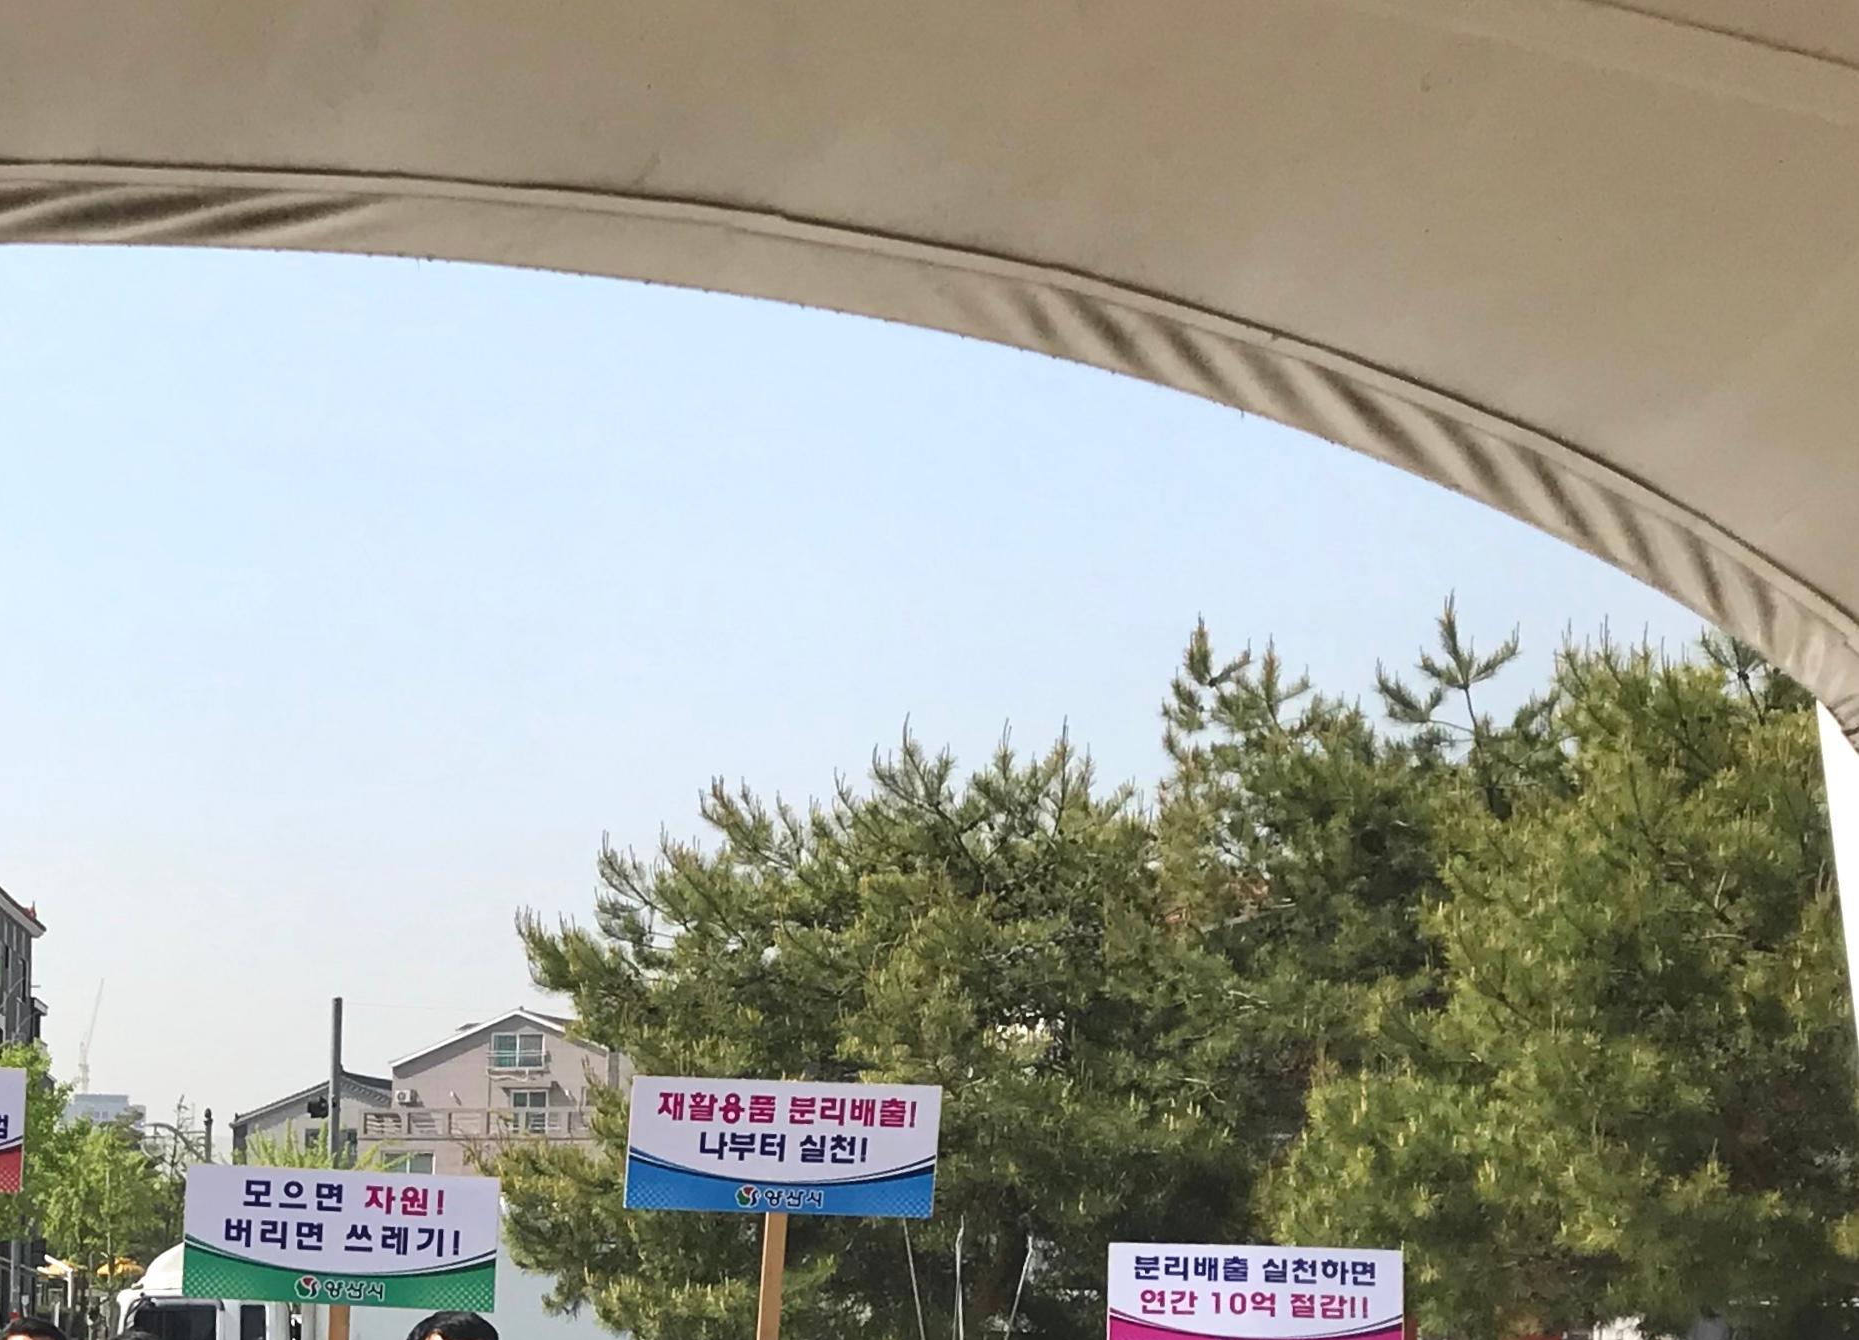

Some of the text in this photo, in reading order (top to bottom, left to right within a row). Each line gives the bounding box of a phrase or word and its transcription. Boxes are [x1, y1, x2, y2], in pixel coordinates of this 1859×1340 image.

[657, 1091, 917, 1128] 재활용품 분리배출!
[699, 1131, 868, 1164] 나부터 실천!
[243, 1179, 445, 1216] 모으면 자원!
[764, 1189, 824, 1208] 양산시
[224, 1218, 460, 1257] 버리면 쓰레기!
[1134, 1255, 1377, 1286] 분리배출 실천하면
[325, 1280, 385, 1300] 양산시
[1140, 1289, 1369, 1319] 연간 10억 절감!!
